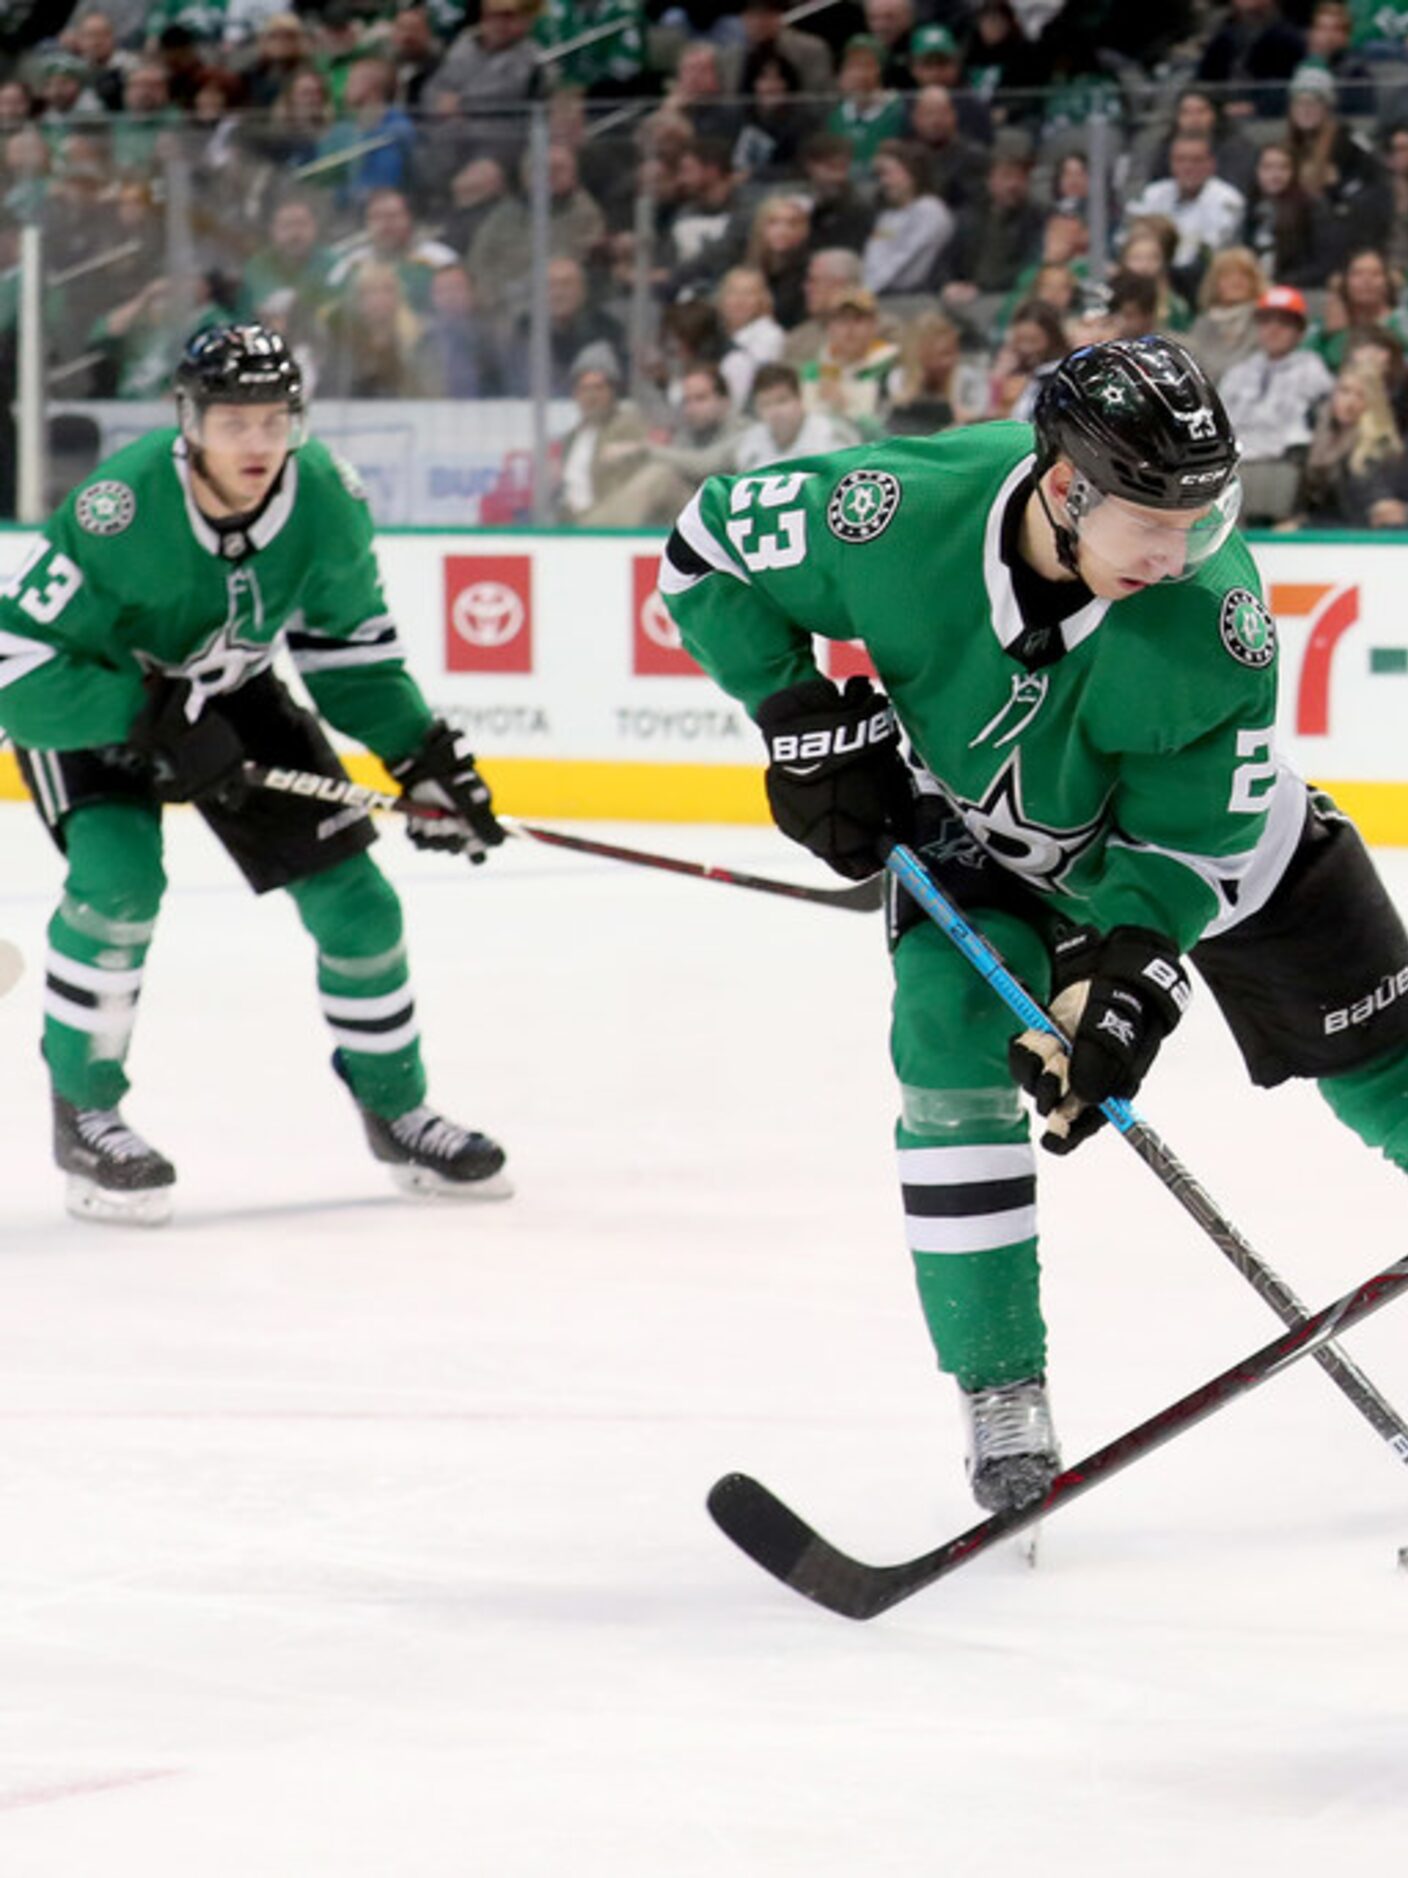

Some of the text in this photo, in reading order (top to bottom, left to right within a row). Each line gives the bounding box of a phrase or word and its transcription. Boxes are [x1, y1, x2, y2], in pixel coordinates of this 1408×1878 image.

[1187, 413, 1217, 441] 23
[725, 471, 820, 573] 23
[614, 707, 739, 738] TOYOTA
